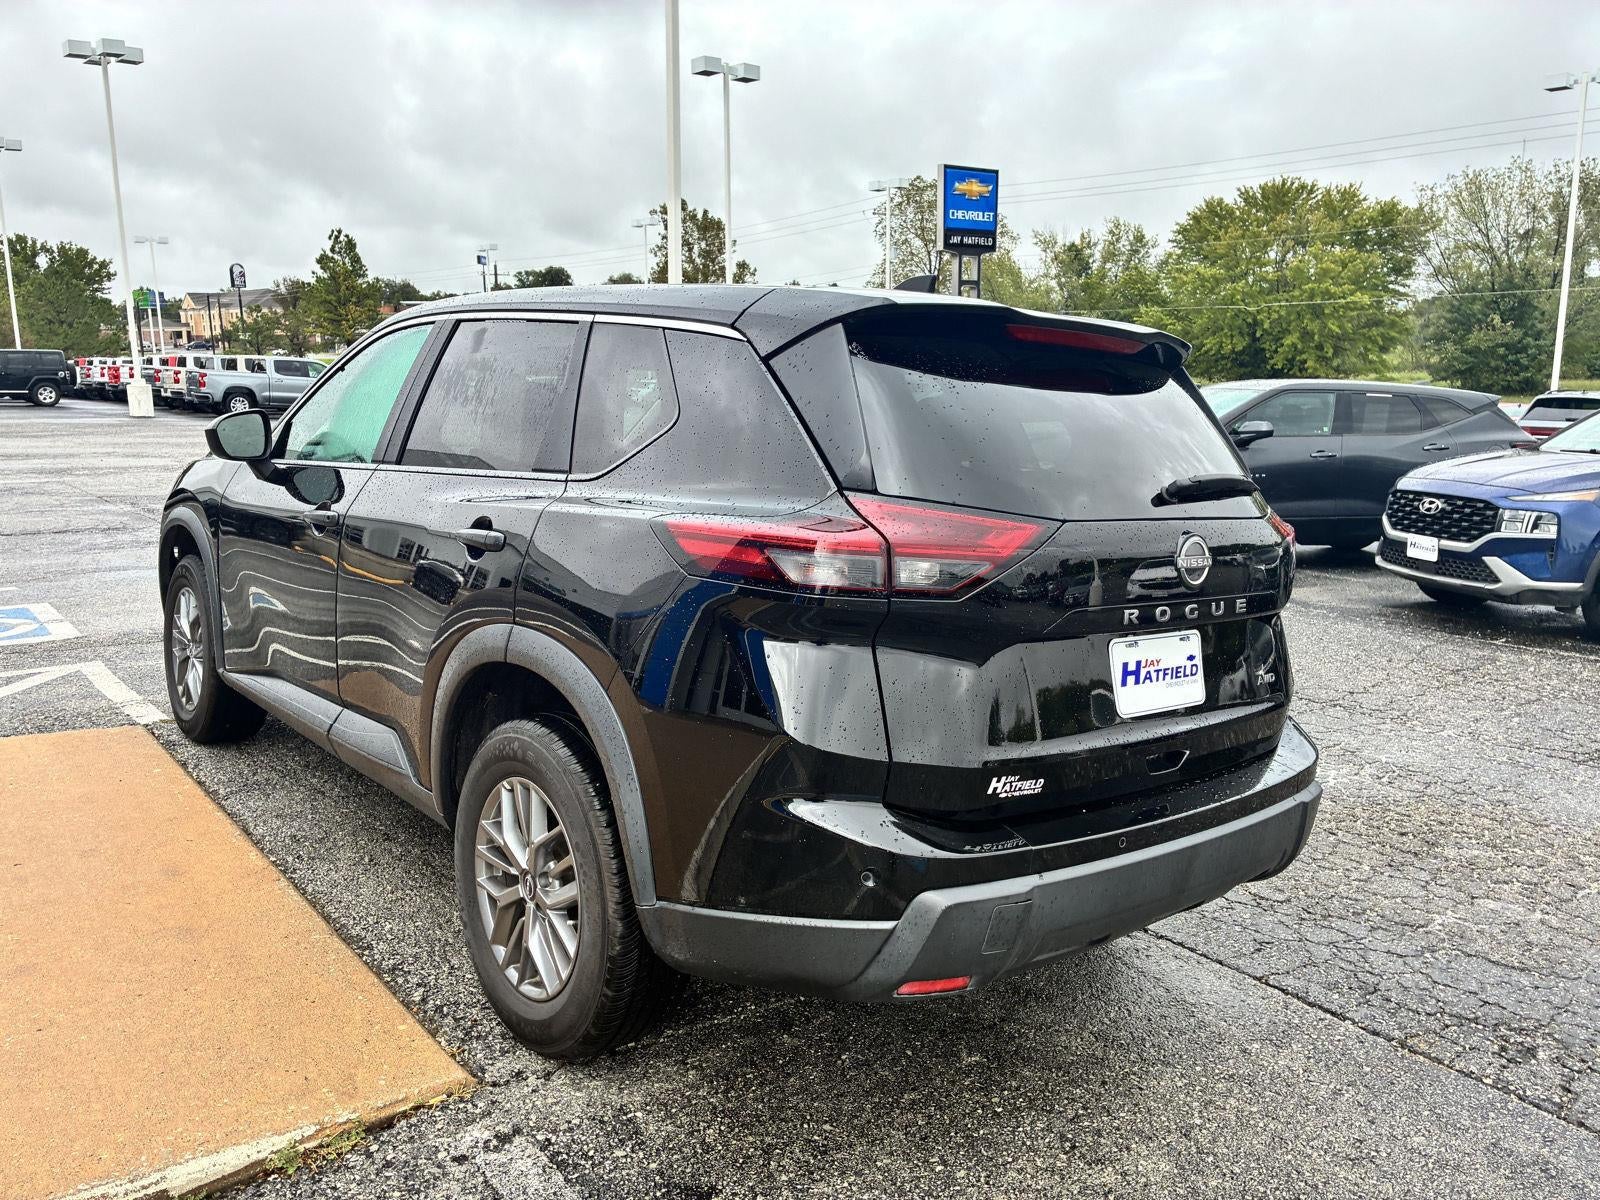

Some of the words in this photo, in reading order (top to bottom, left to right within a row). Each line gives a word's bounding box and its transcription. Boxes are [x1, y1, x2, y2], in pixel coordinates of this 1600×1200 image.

[949, 209, 994, 221] CHEVROLET
[949, 235, 961, 244] JAY
[963, 236, 993, 246] HATFIELD
[1178, 557, 1212, 568] NISSAN
[1123, 598, 1247, 625] ROGUE
[1142, 659, 1162, 669] JAY
[1121, 660, 1199, 687] HATFIELD
[1004, 775, 1020, 783] JAY
[987, 776, 1044, 794] HATFIELD
